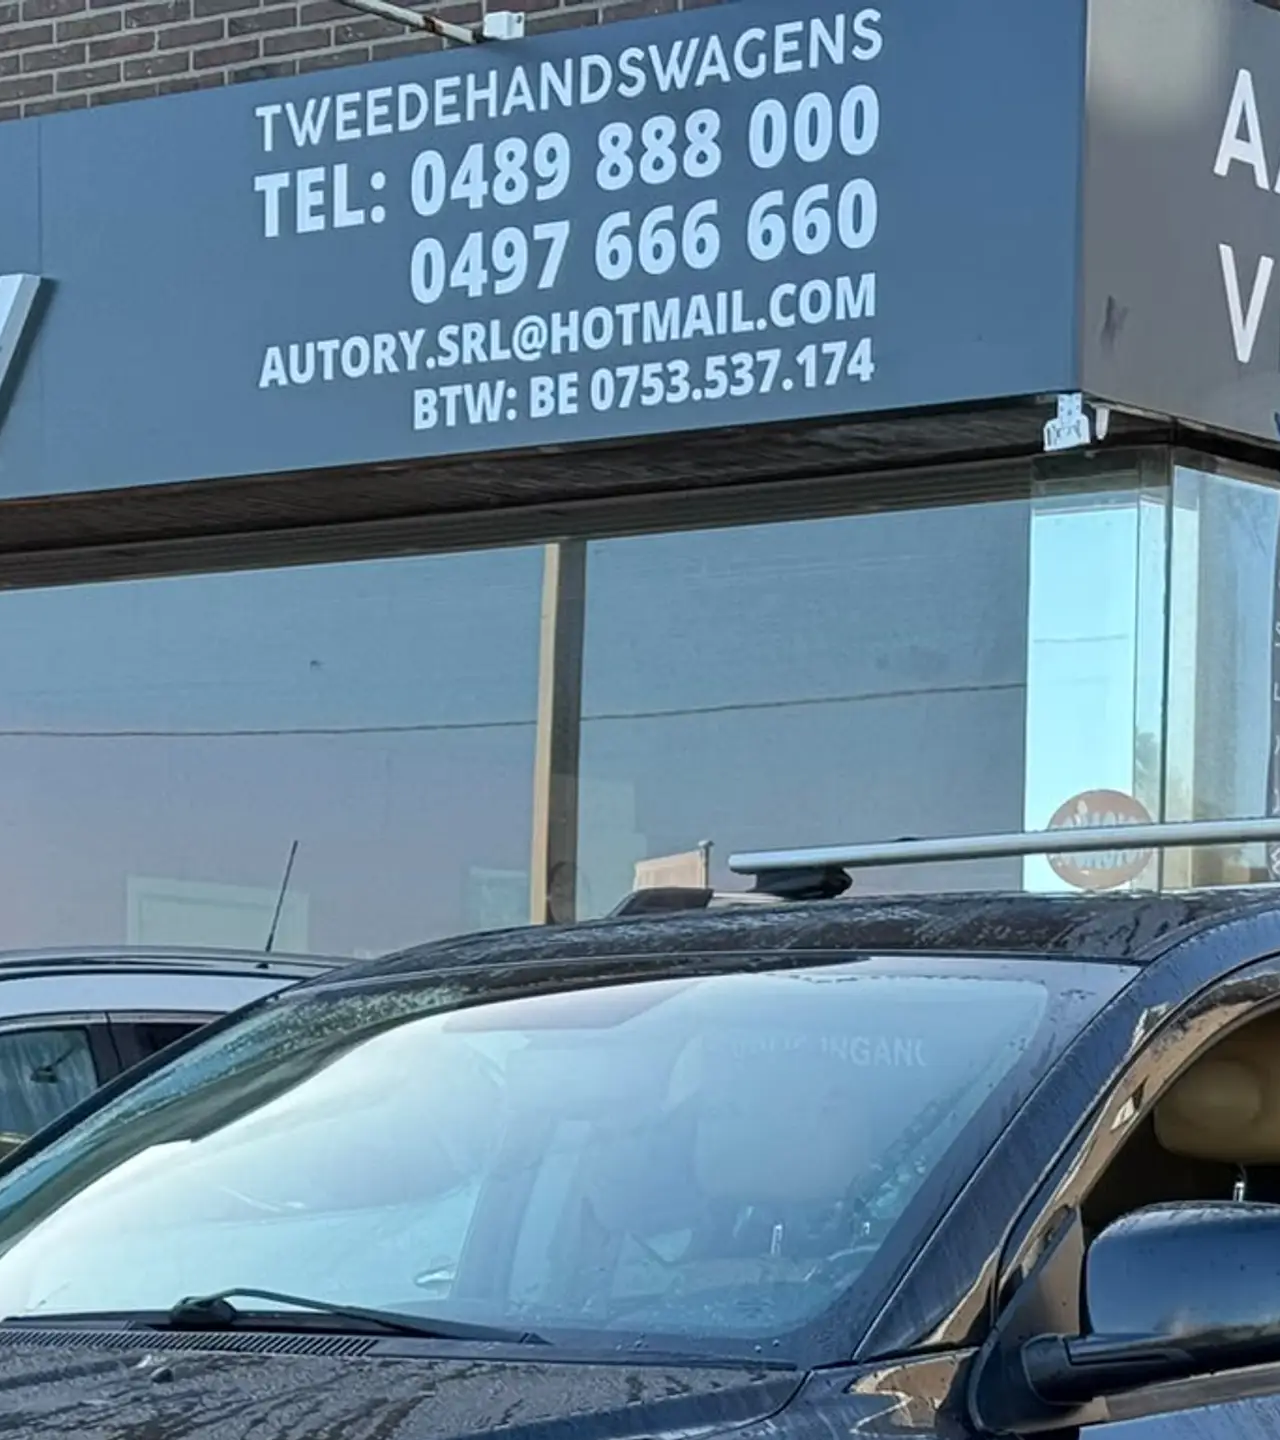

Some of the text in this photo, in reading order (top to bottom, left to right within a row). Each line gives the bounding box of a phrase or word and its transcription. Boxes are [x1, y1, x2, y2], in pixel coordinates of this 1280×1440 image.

[255, 8, 883, 151] TWEEDEHANDSWAGENS
[254, 84, 880, 238] TEL: 0489 888 000
[411, 178, 877, 303] 0497 666 660
[258, 272, 876, 389] AUTORY.SRL@HOTMAIL.COM
[413, 337, 874, 431] BTW: BE 0753.537.174
